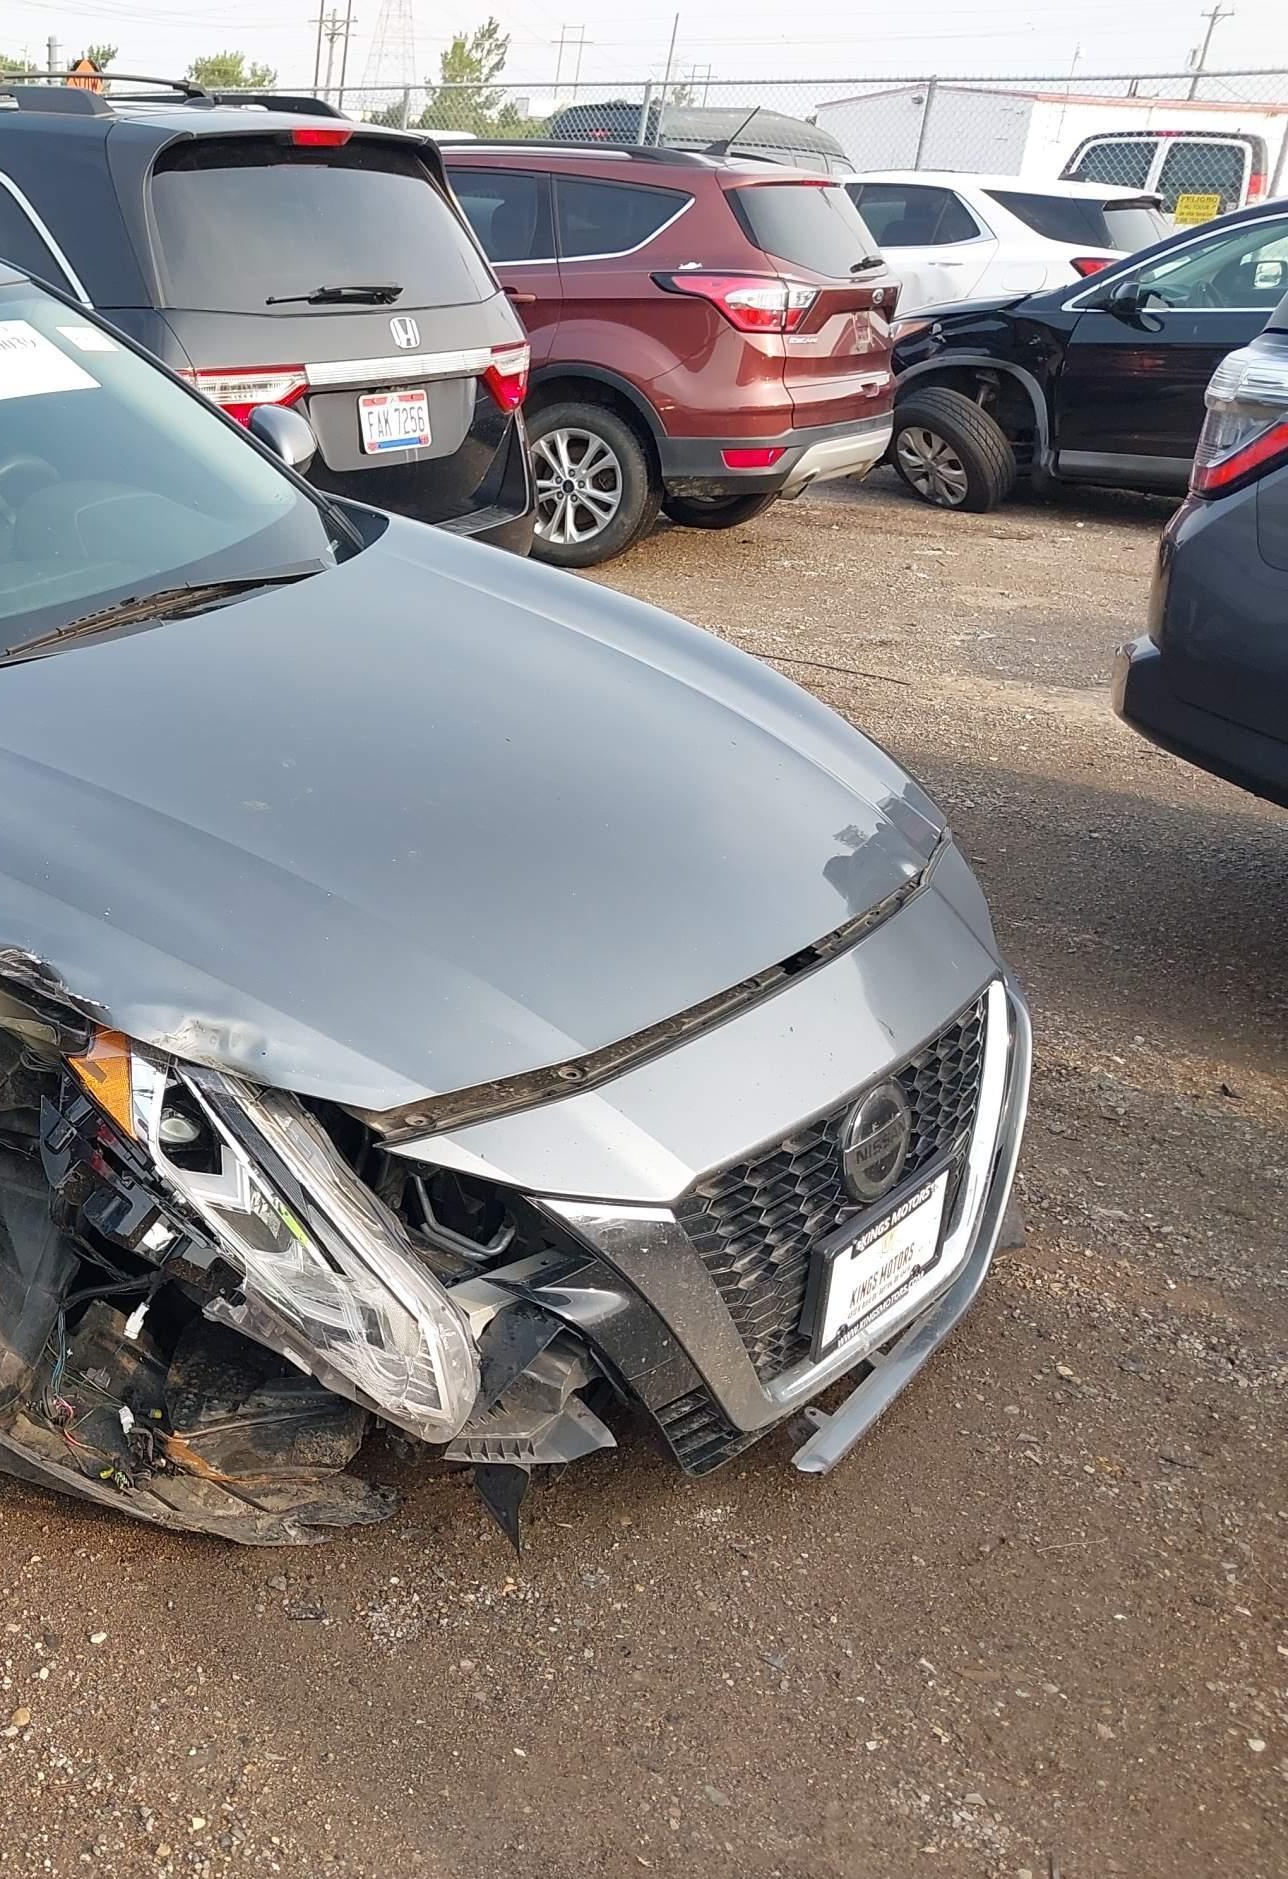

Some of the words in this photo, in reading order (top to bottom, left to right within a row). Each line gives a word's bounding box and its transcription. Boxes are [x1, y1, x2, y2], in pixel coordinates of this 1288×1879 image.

[367, 407, 393, 439] FAK
[394, 406, 426, 435] 7256
[855, 1119, 907, 1165] NISSAN
[861, 1217, 891, 1247] KINGS
[891, 1184, 932, 1226] MOTORS
[849, 1270, 879, 1309] KINGS
[879, 1241, 915, 1285] MOTORS
